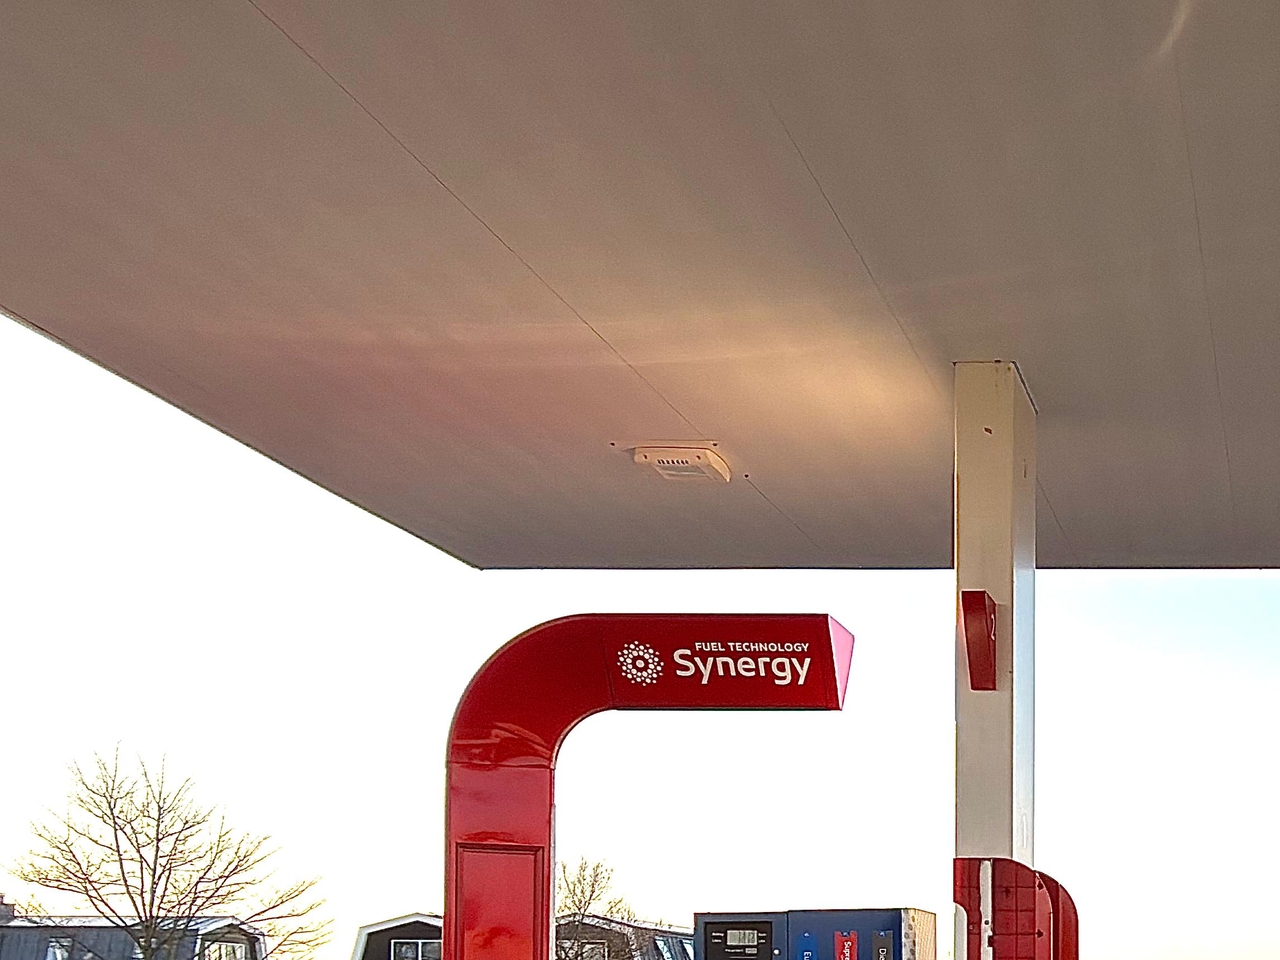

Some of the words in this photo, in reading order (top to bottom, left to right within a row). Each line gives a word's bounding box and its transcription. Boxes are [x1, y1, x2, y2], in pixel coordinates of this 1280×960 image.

[695, 642, 725, 652] FUEL
[727, 642, 809, 652] TECHNOLOGY
[673, 648, 811, 685] Synergy
